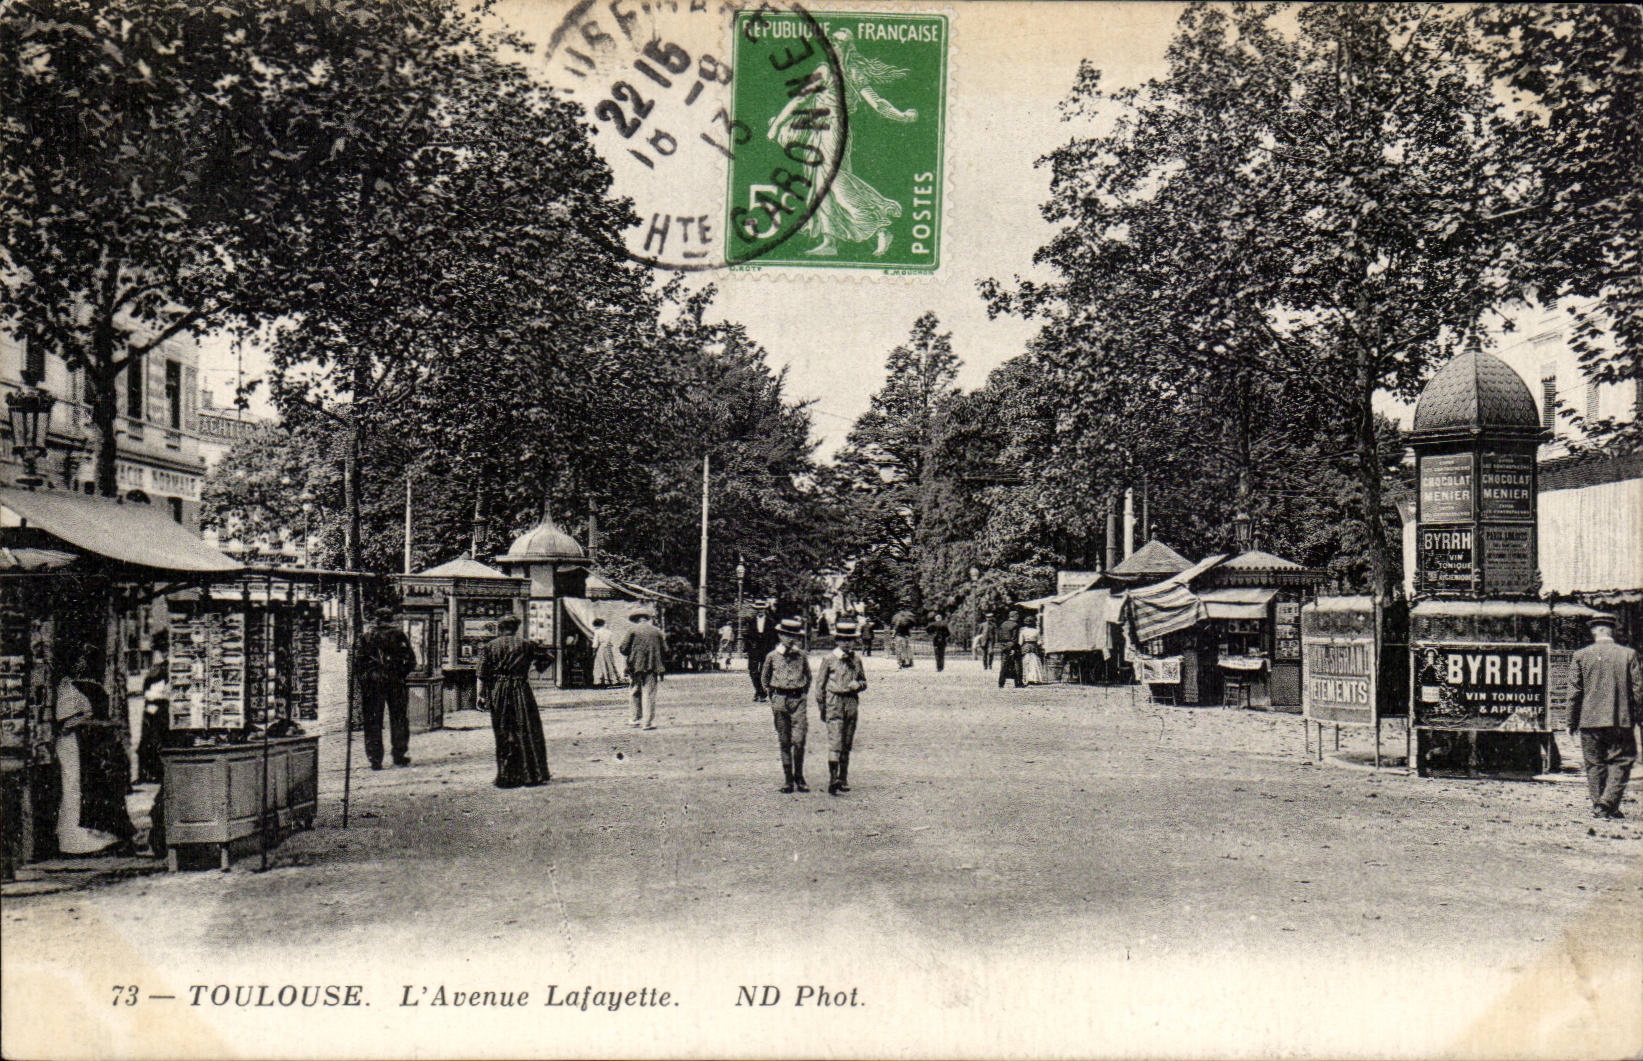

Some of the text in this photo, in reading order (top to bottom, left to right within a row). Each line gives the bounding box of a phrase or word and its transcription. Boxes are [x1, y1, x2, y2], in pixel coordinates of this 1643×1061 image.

[857, 22, 939, 44] FRANÇAISE
[594, 80, 656, 139] 22
[912, 171, 933, 255] POSTES
[1422, 474, 1471, 488] CHOCOLAT
[1482, 474, 1530, 485] CHOCOLAT
[1423, 490, 1470, 502] MENIER
[1483, 488, 1529, 499] MENIER
[1424, 532, 1472, 550] BYRRH
[1448, 653, 1543, 686] BYRRH
[1466, 692, 1487, 701] VIN
[1492, 692, 1541, 703] TONIQUE
[1479, 705, 1488, 714] &
